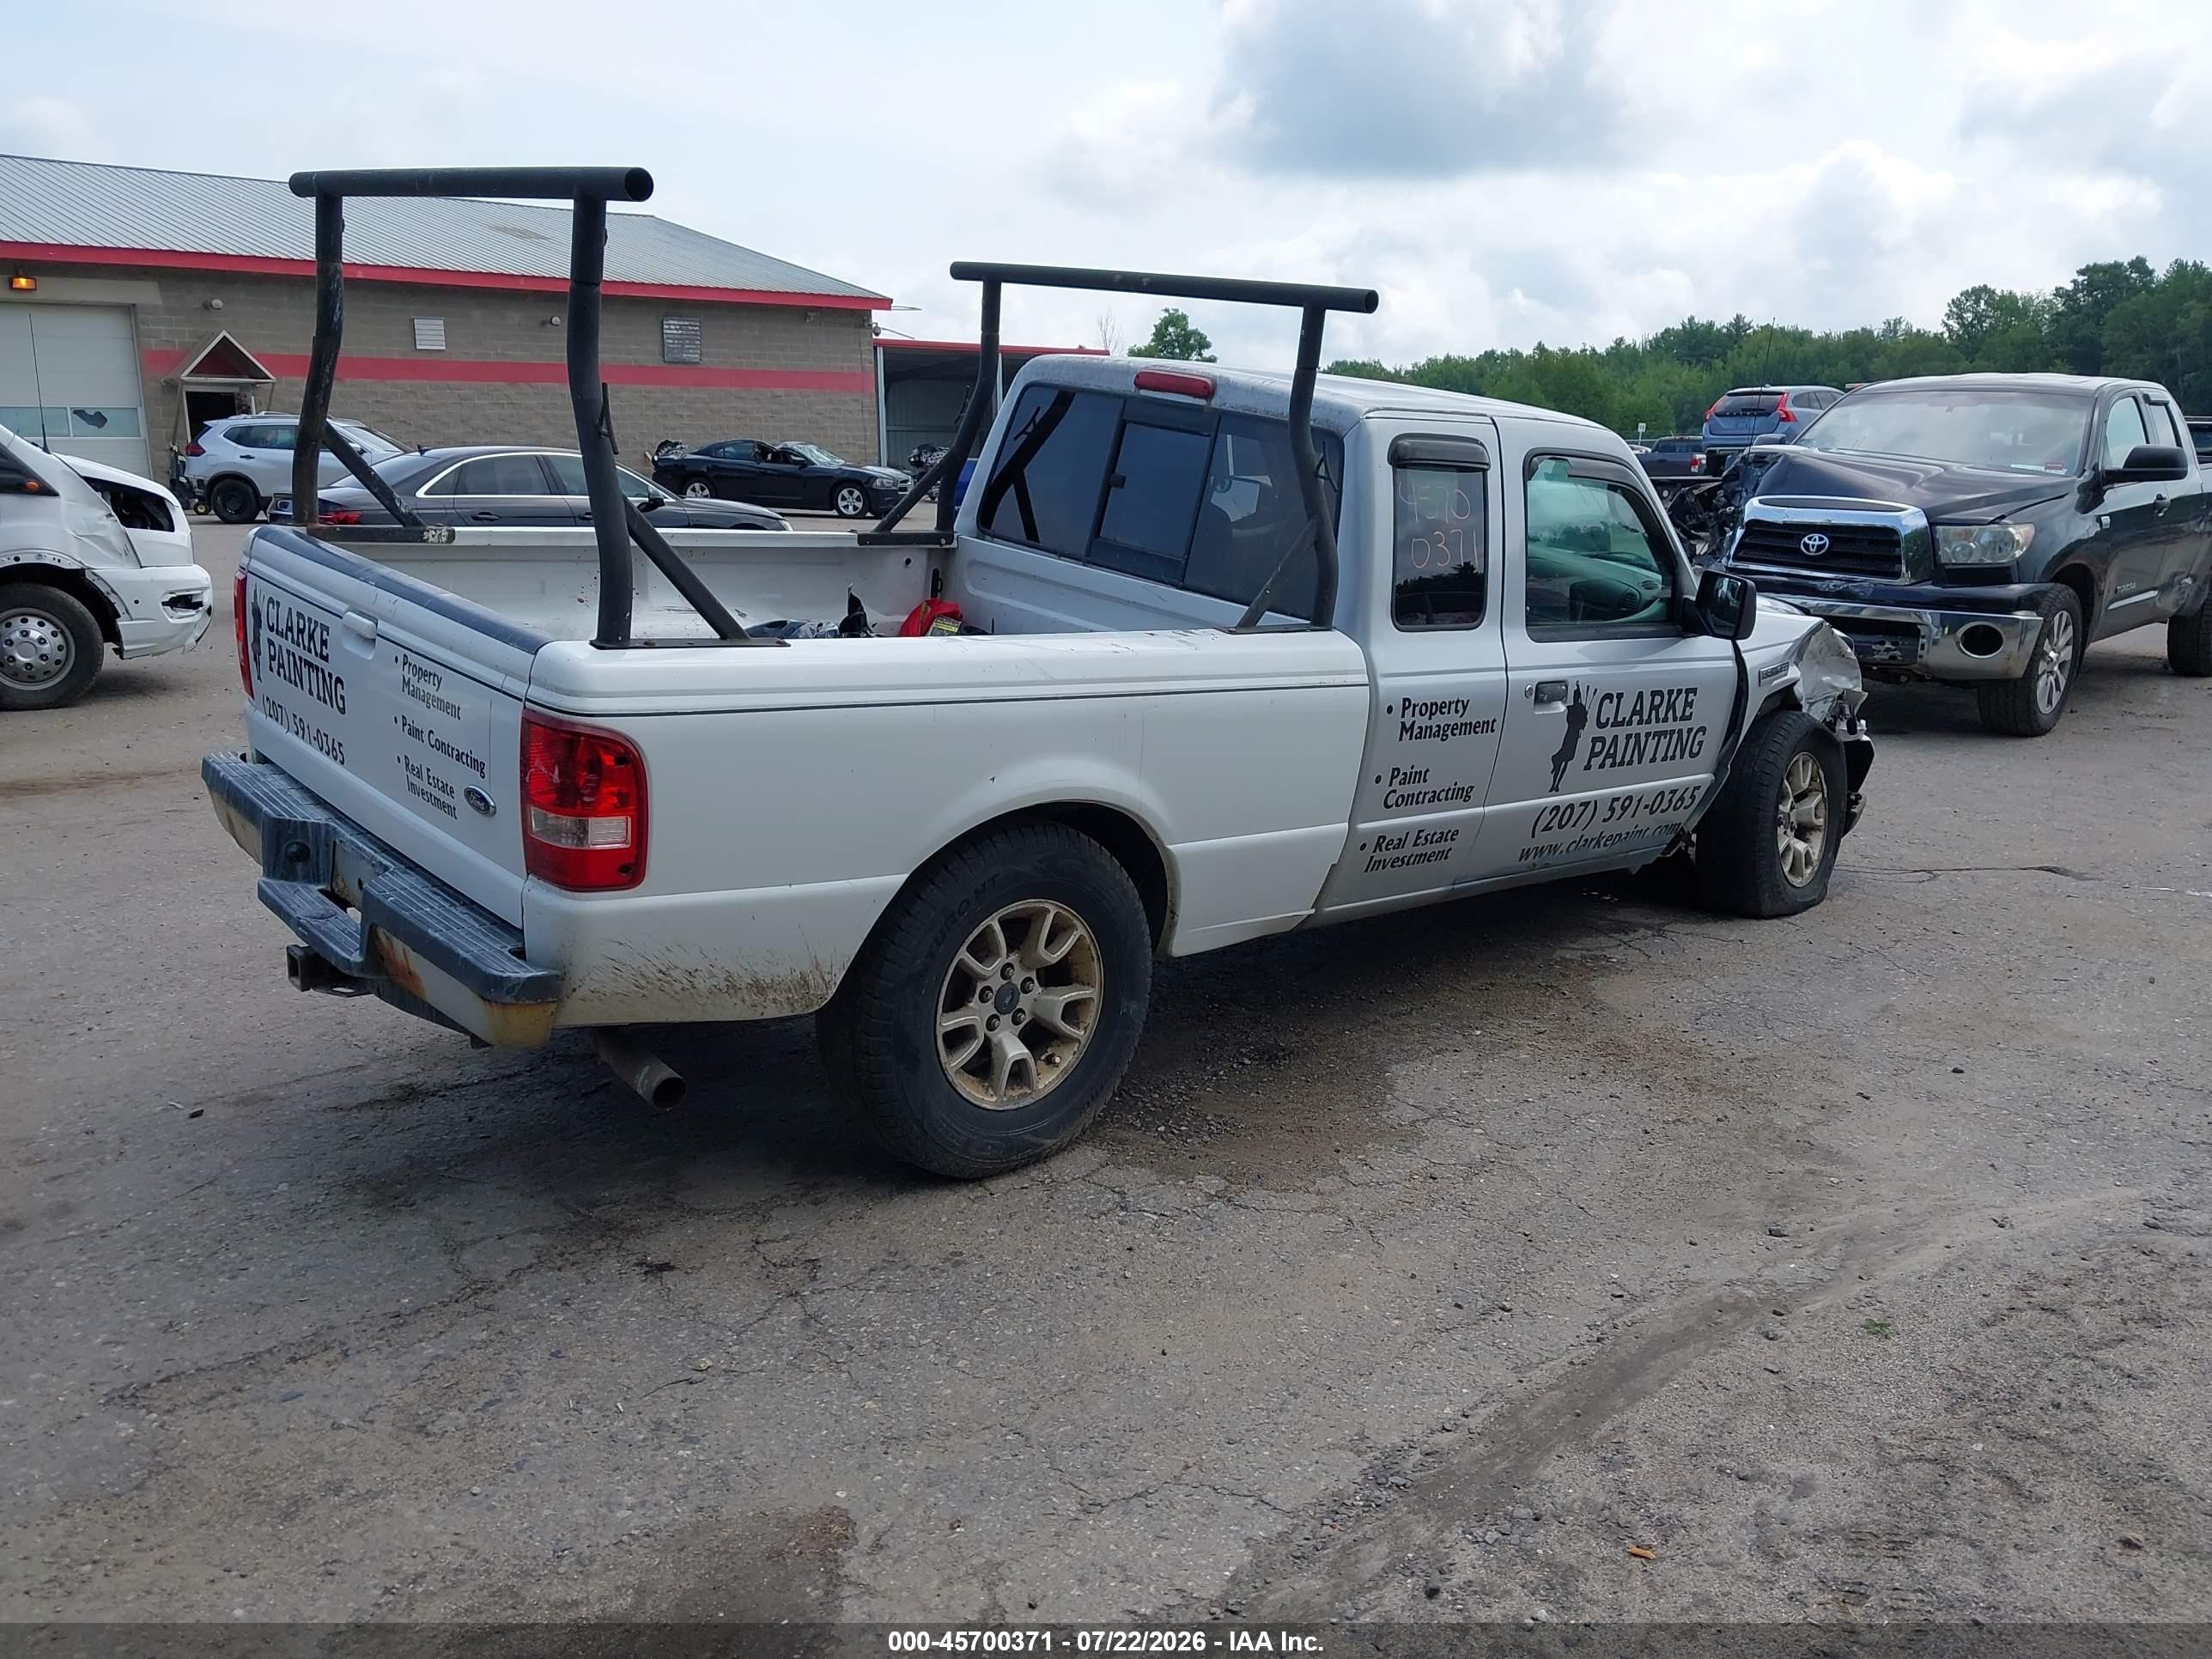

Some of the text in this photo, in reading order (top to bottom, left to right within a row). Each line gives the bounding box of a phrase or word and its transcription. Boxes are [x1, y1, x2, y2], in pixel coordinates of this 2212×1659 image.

[1396, 480, 1471, 523] 4570
[1411, 528, 1479, 568] 0371
[266, 596, 331, 662] CLARKE
[267, 638, 346, 715] PAINTING
[402, 653, 442, 690] Property
[401, 674, 461, 721] Management
[1401, 696, 1471, 721] Property
[1595, 687, 1698, 730] CLARKE
[262, 694, 345, 765] (207) 591-0365
[401, 714, 486, 779] Paint Contracting
[1398, 715, 1498, 744] Management
[1583, 725, 1707, 772] PAINTING
[404, 754, 455, 799] Real Estate
[1382, 781, 1476, 810] Contracting
[1389, 764, 1430, 787] Paint
[406, 778, 458, 820] Investment
[1531, 785, 1702, 839] (207) 591-0365
[1364, 846, 1451, 874] Investment
[1371, 826, 1460, 854] Real Estate
